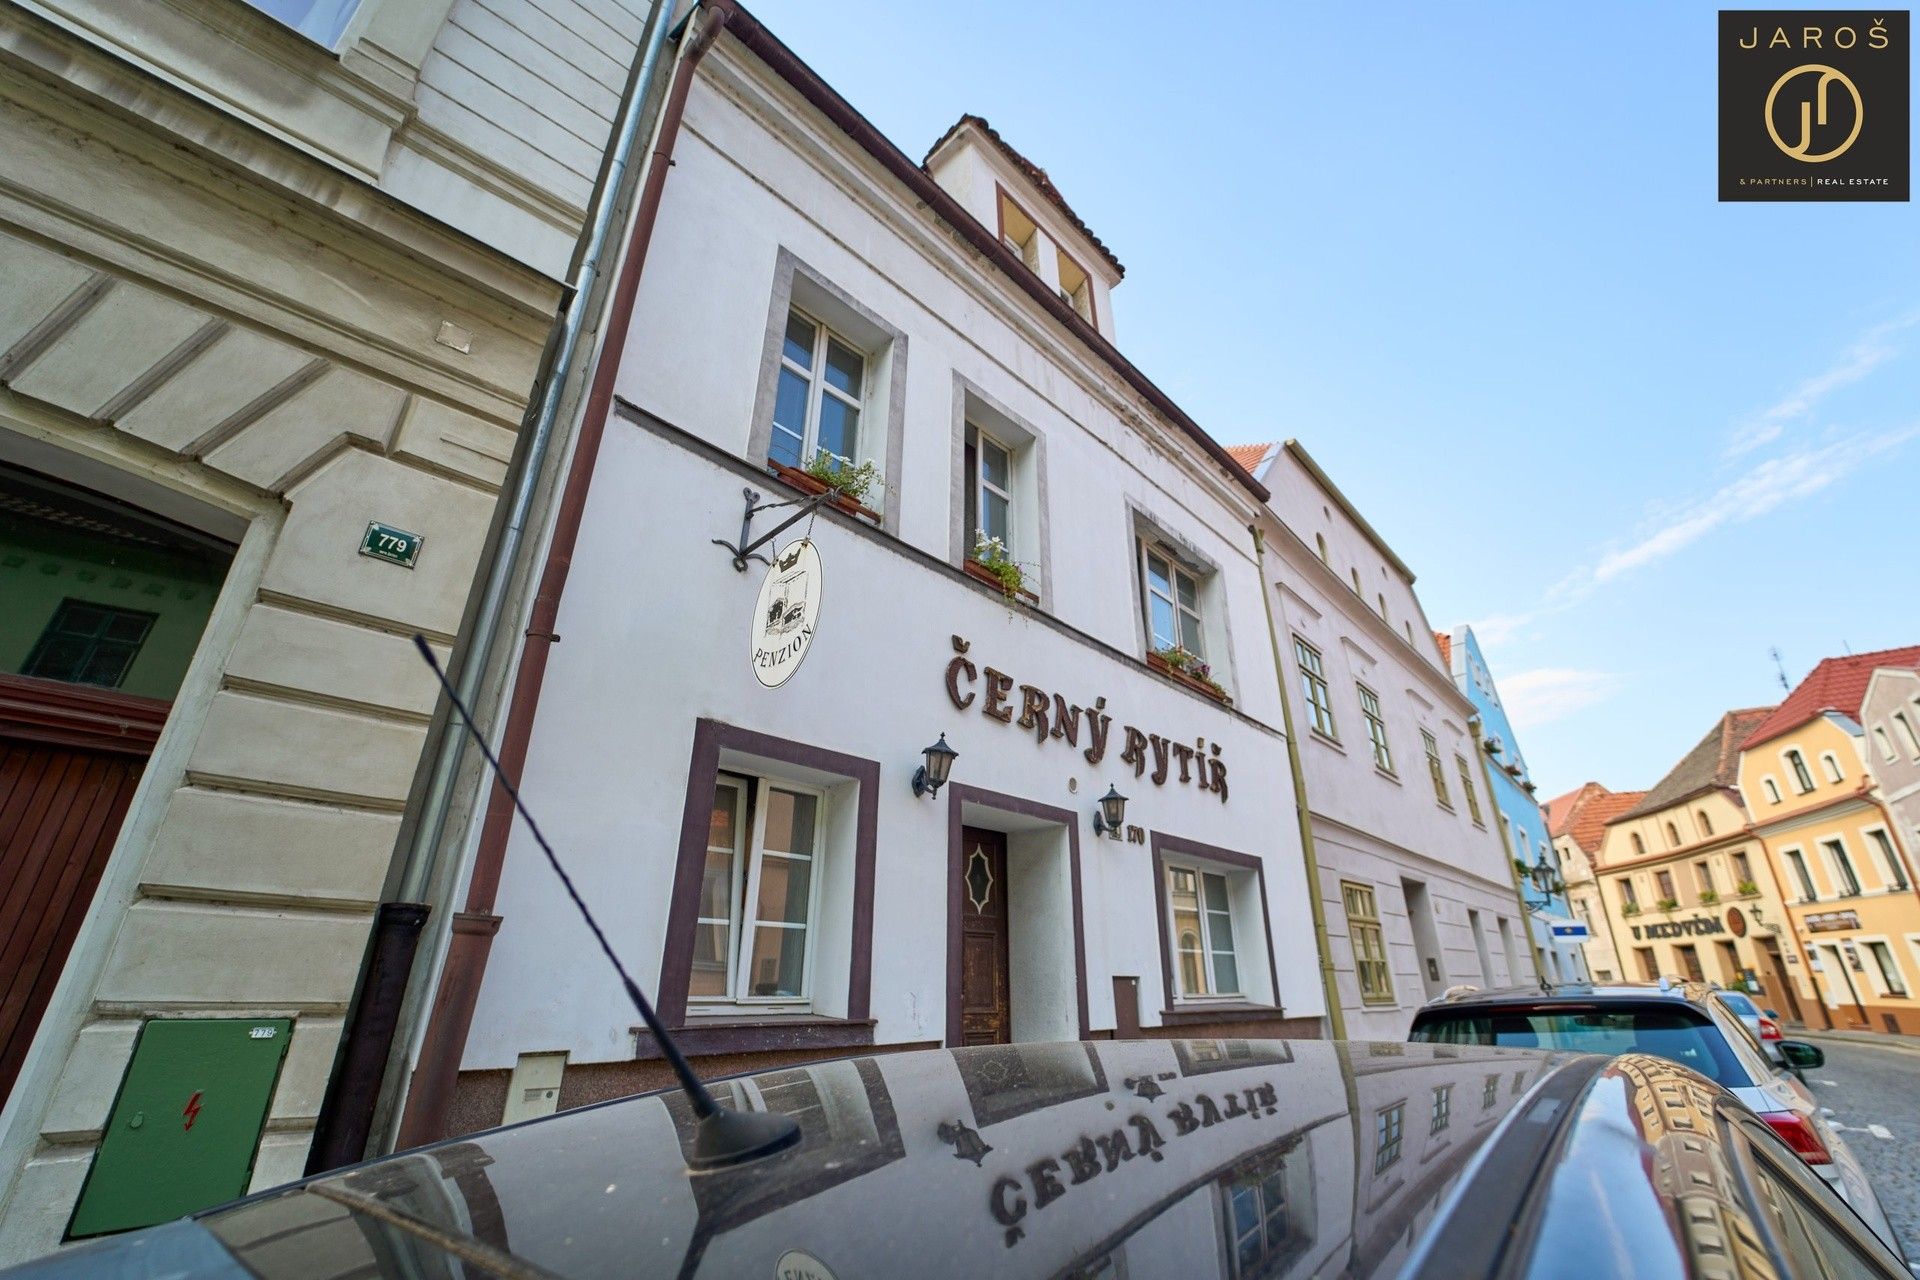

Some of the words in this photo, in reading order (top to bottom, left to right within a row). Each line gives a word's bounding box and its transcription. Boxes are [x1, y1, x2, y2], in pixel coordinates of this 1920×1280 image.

[378, 533, 407, 552] 779
[753, 624, 812, 668] PENZION
[945, 634, 1112, 765] ČERNÝ
[1120, 725, 1229, 804] RYTÍŘ
[1631, 926, 1642, 940] U
[254, 1028, 273, 1036] 779
